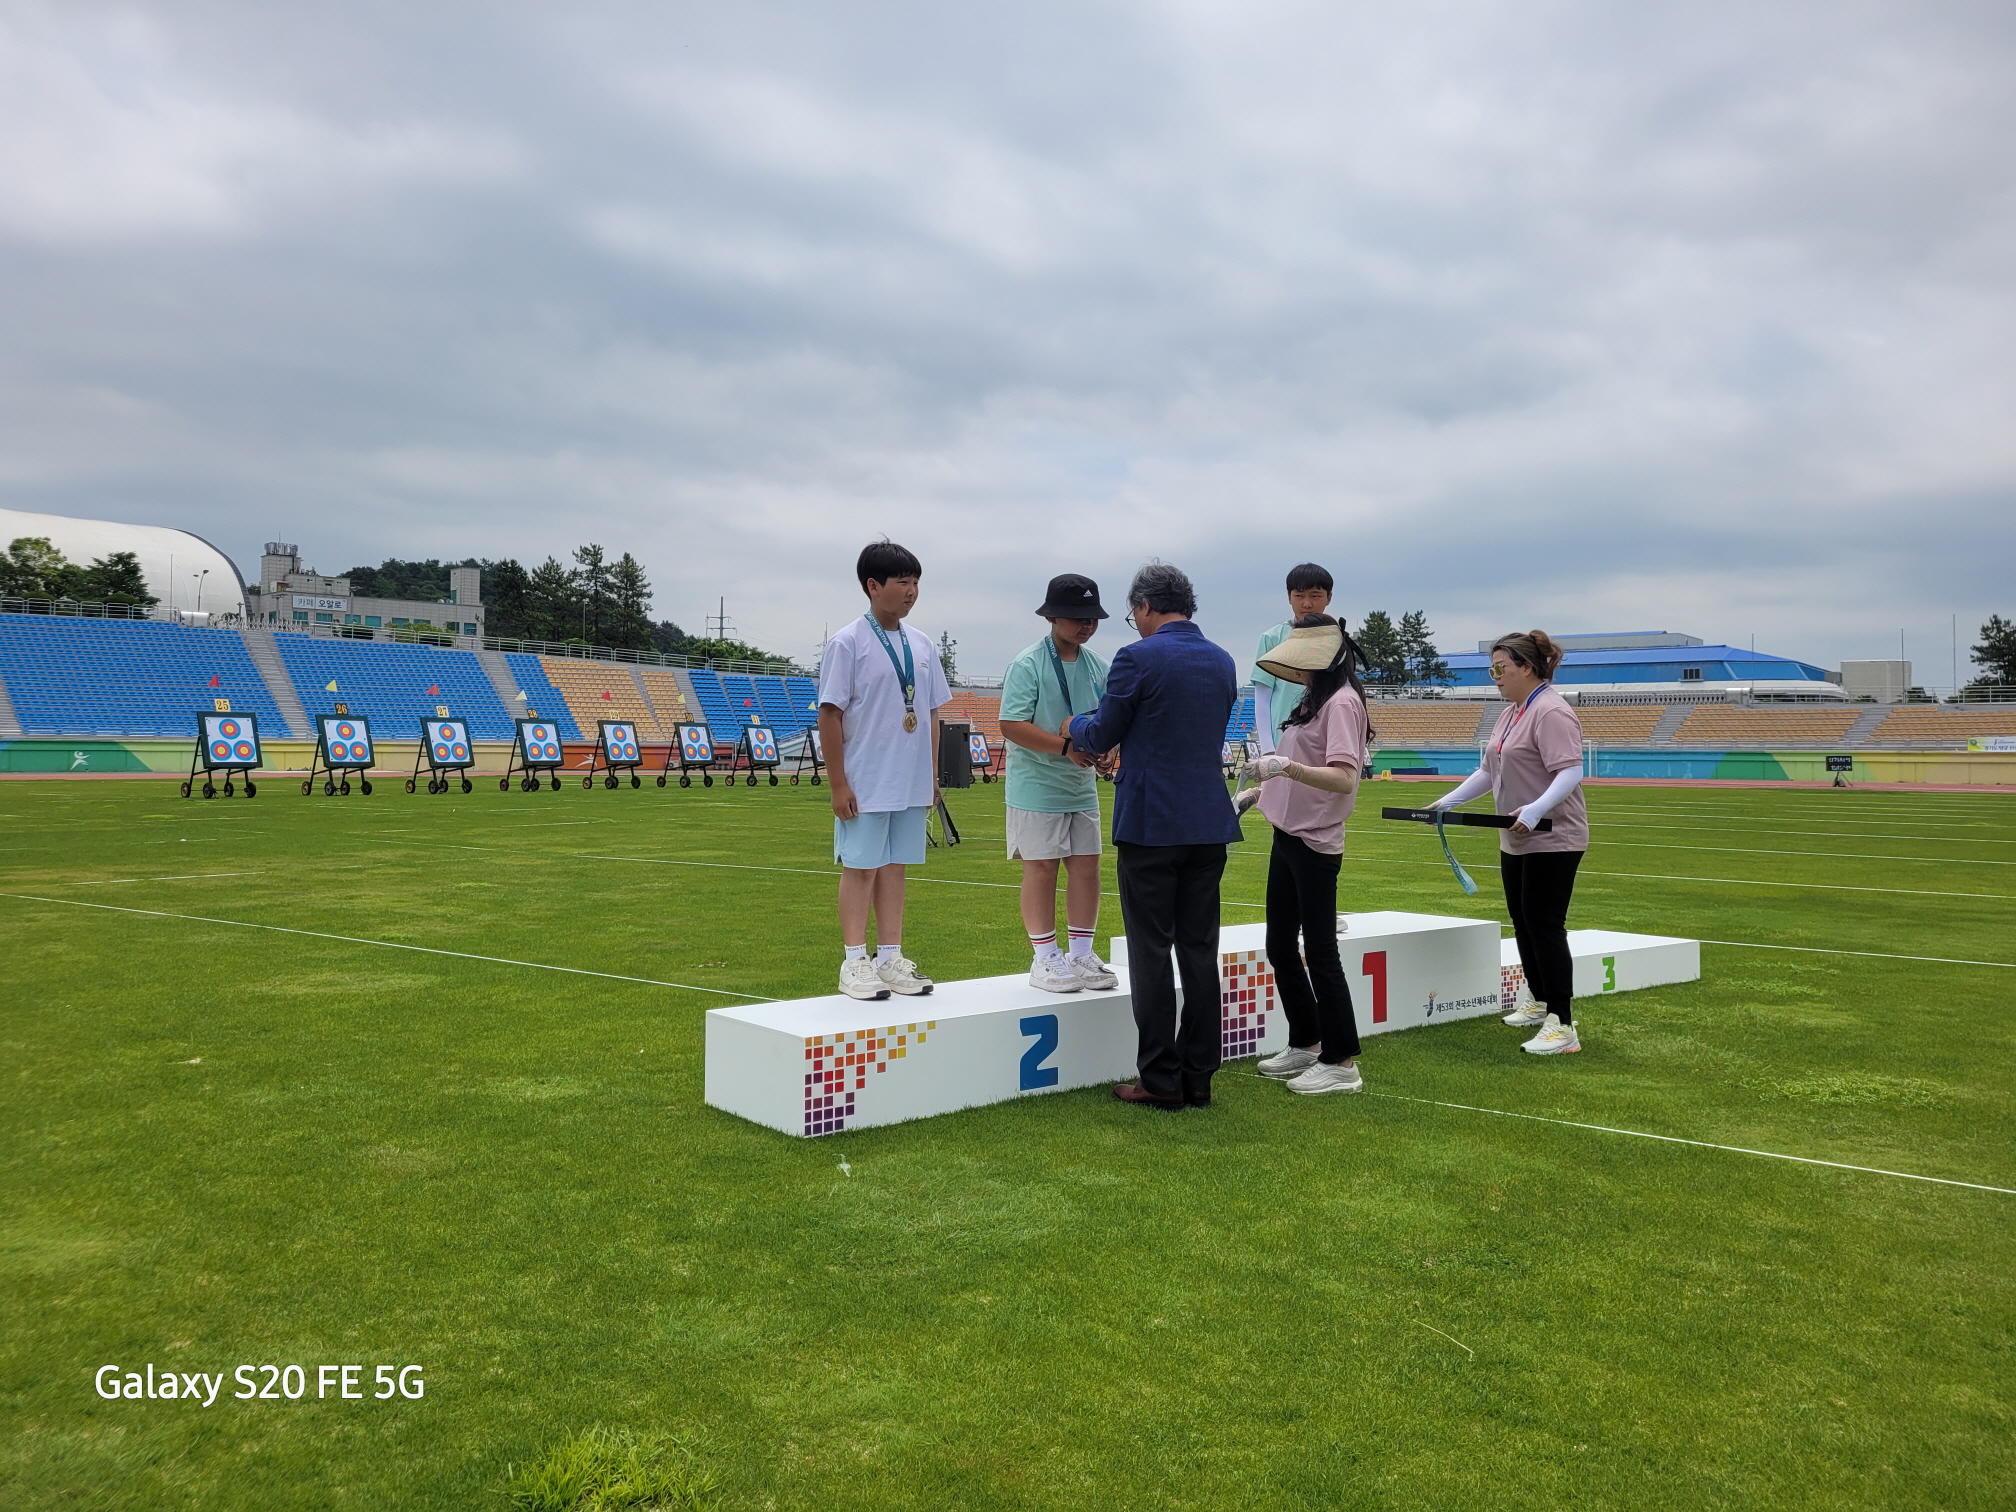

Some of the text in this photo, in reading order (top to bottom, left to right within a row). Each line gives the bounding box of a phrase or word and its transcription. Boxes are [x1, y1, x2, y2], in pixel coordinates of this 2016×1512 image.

[298, 598, 313, 607] 카페
[216, 700, 229, 710] 25
[335, 703, 348, 714] 26
[437, 706, 448, 717] 27
[1602, 956, 1615, 991] 3
[1363, 951, 1388, 1024] 1
[1436, 994, 1498, 1013] 제53회 전국소년체육대회
[1020, 1014, 1058, 1091] 2
